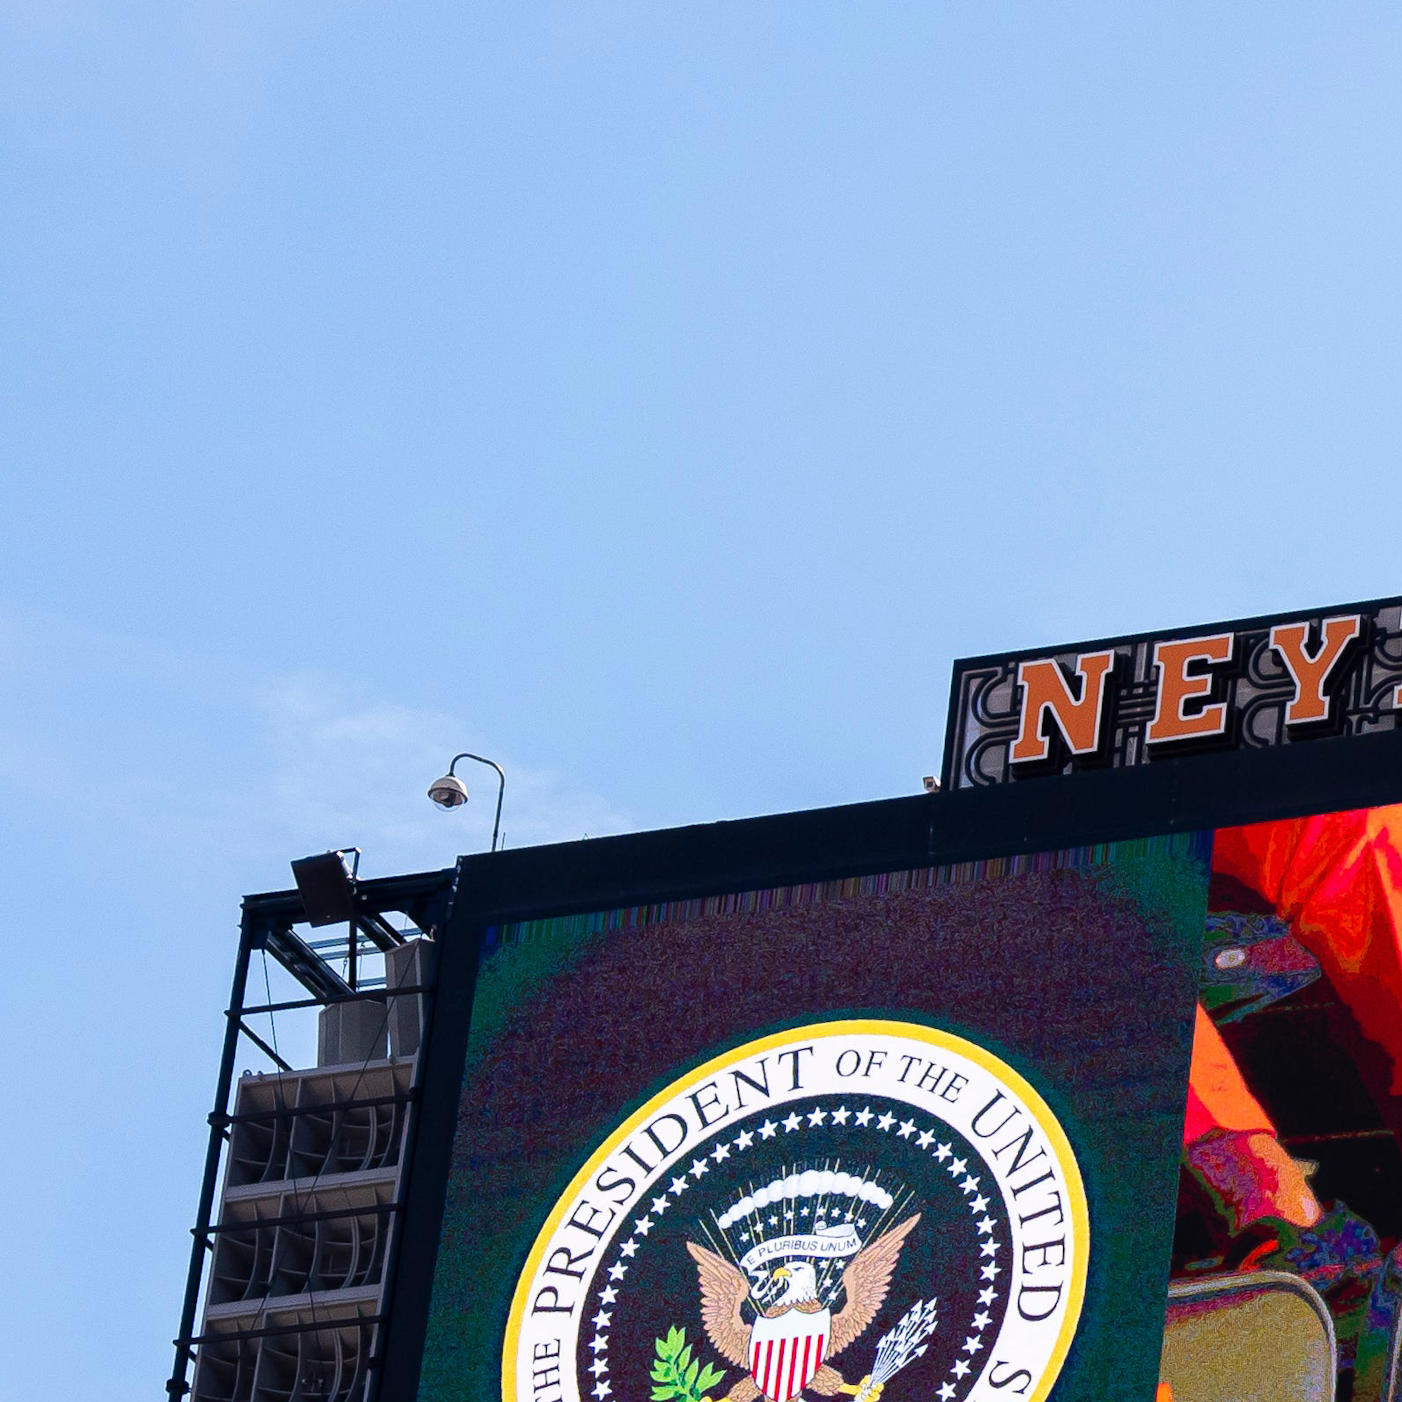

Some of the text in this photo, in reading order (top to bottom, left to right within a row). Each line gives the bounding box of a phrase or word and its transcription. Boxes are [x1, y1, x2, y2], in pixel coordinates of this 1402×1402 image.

[532, 1047, 813, 1316] PRESIDENT
[836, 1050, 887, 1077] OF
[897, 1055, 970, 1103] THE
[972, 1089, 1066, 1321] UNITED
[748, 1237, 858, 1265] E PLURIBUS UNUM
